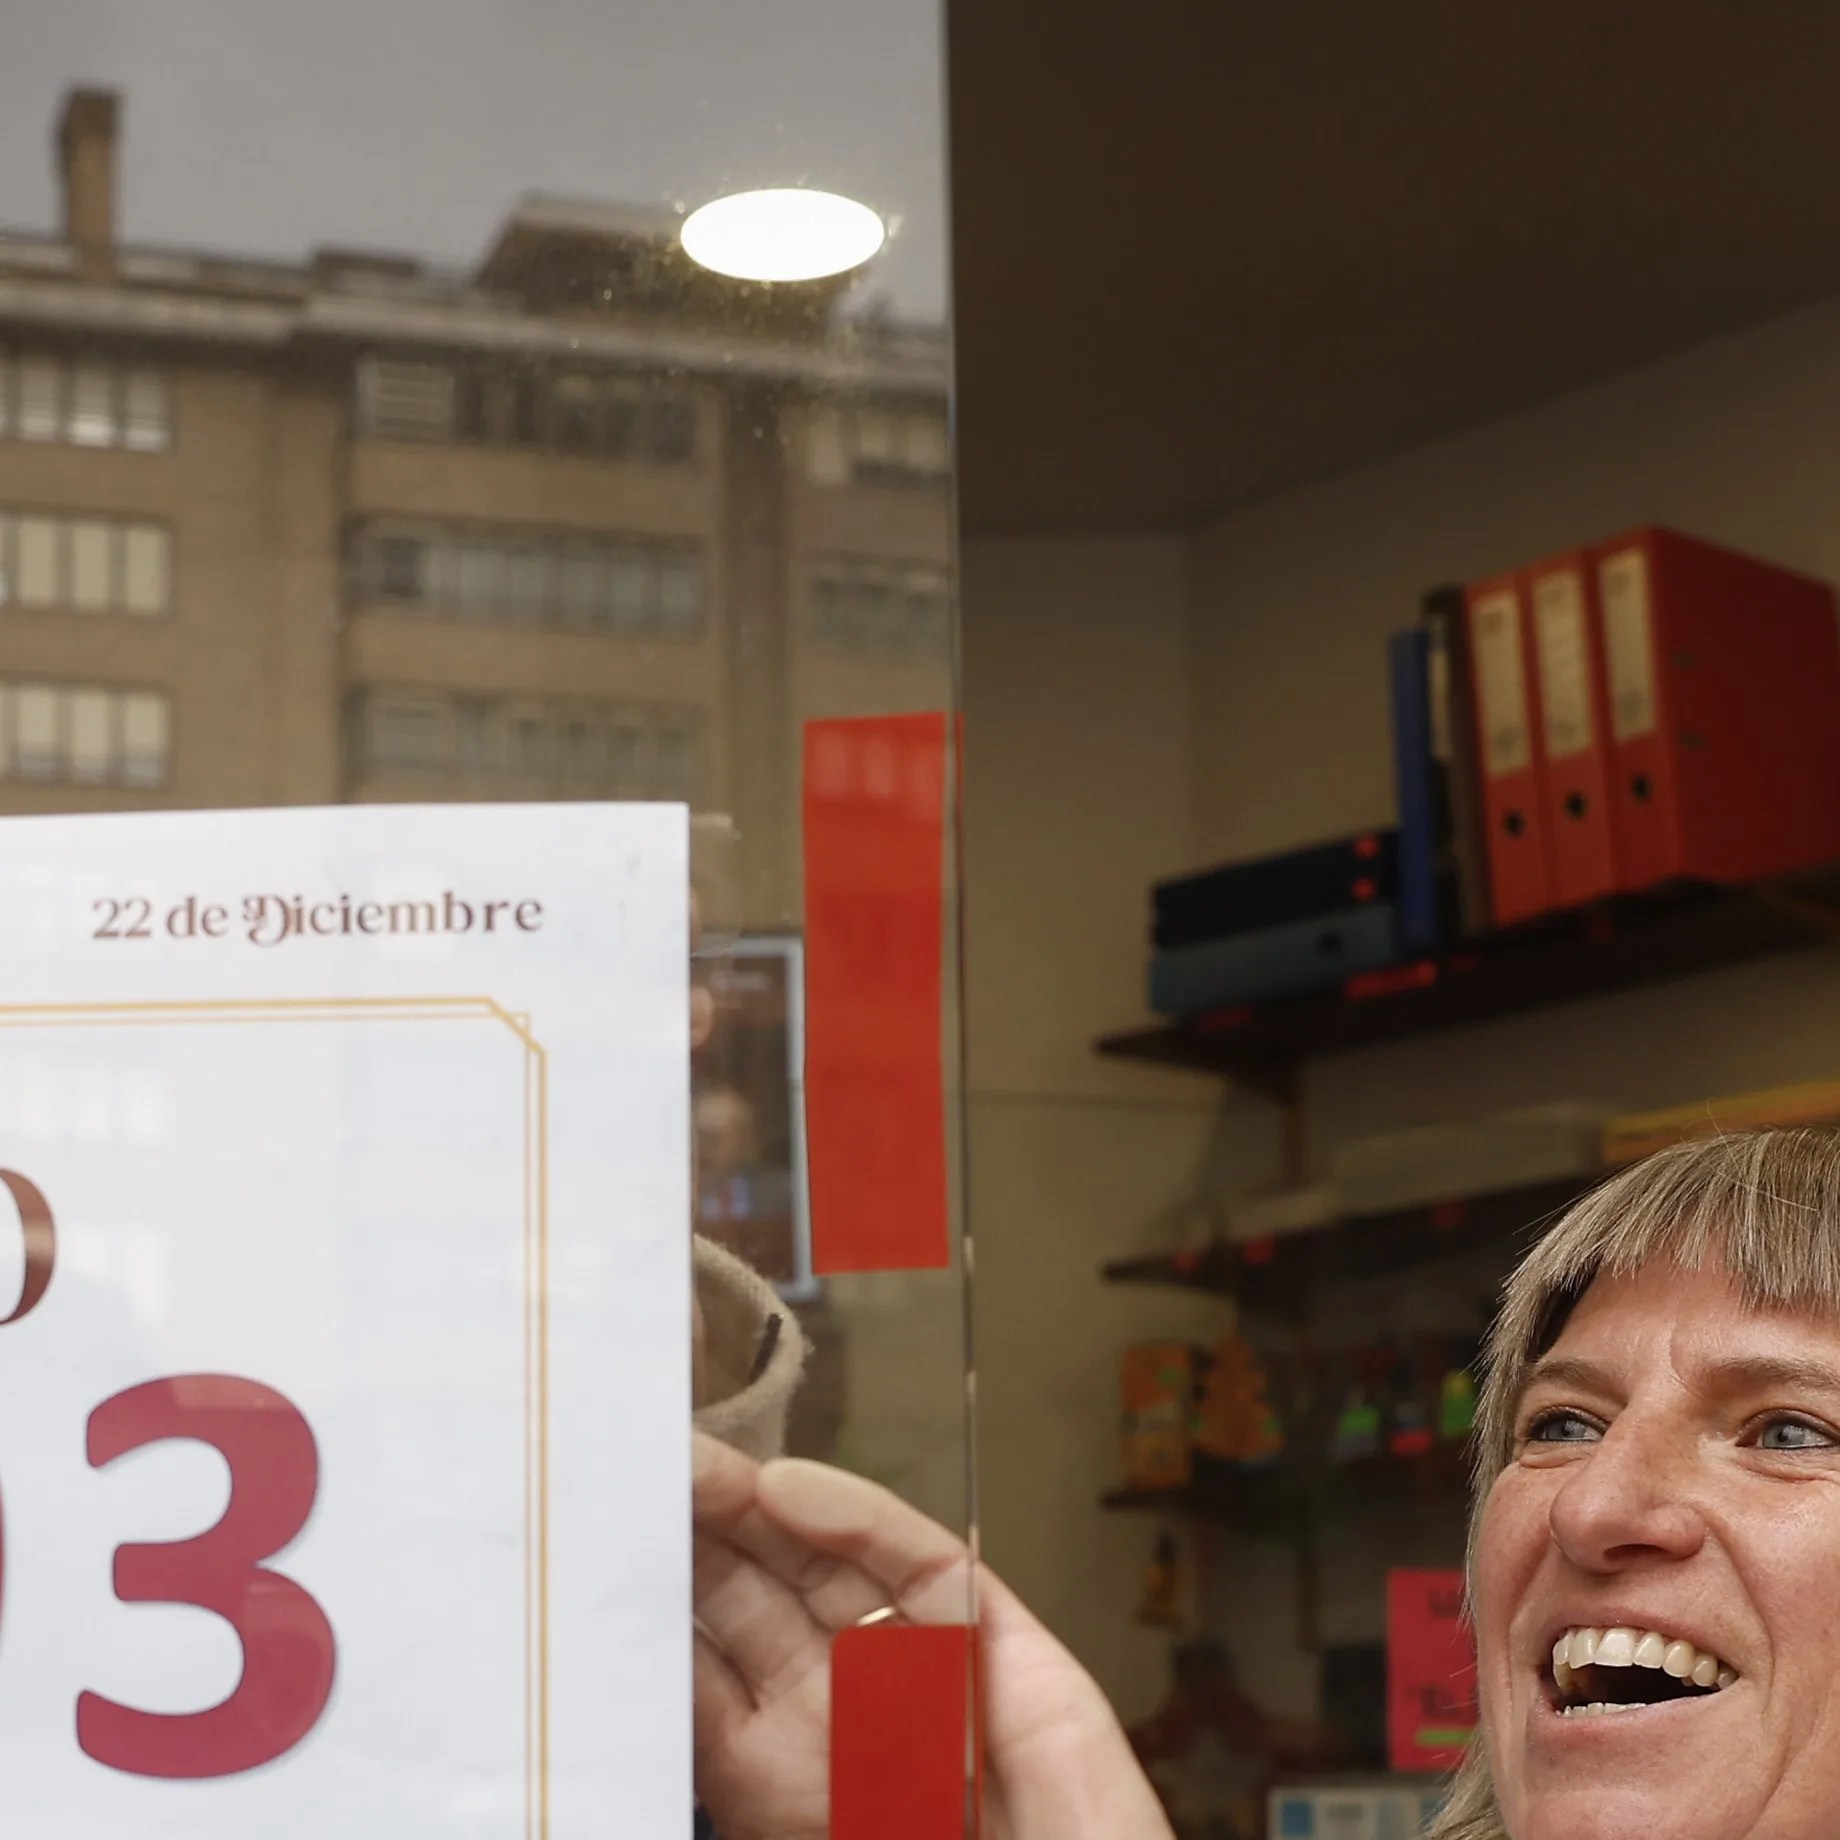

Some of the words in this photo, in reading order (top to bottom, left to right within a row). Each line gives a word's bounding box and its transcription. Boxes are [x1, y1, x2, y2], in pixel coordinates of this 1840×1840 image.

[92, 896, 153, 939] 22
[166, 895, 229, 938] de
[242, 889, 544, 947] Diciembre
